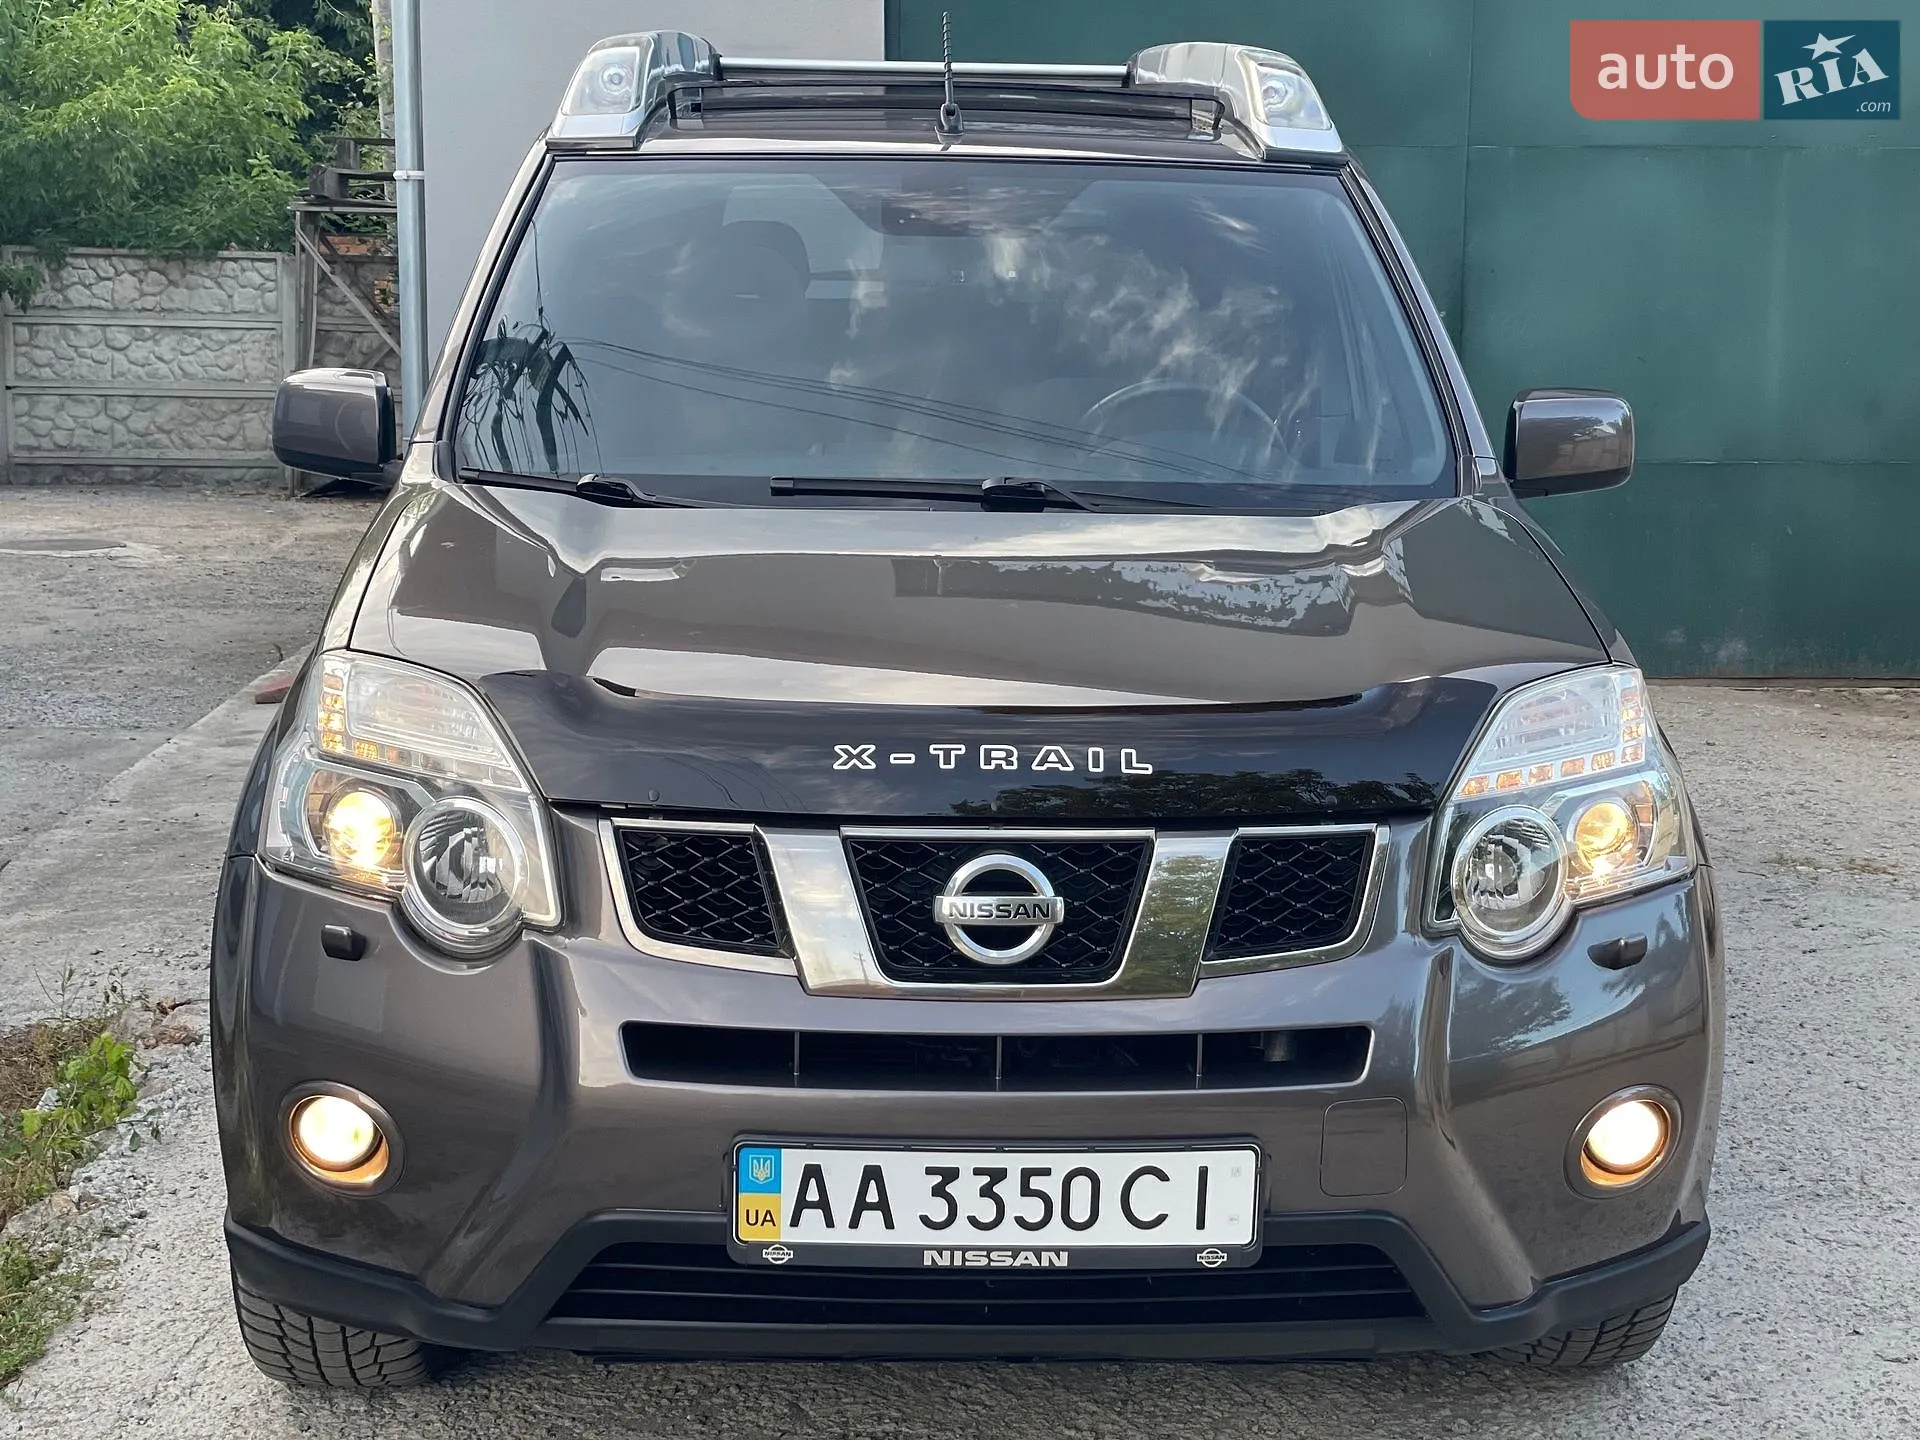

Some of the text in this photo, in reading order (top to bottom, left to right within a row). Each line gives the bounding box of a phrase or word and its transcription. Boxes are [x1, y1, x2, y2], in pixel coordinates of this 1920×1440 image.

[832, 743, 1153, 775] X-TRAIL
[948, 901, 1052, 920] NISSAN
[788, 1163, 1209, 1232] AA 3350 CI
[745, 1208, 777, 1228] UA
[922, 1249, 1069, 1268] NISSAN
